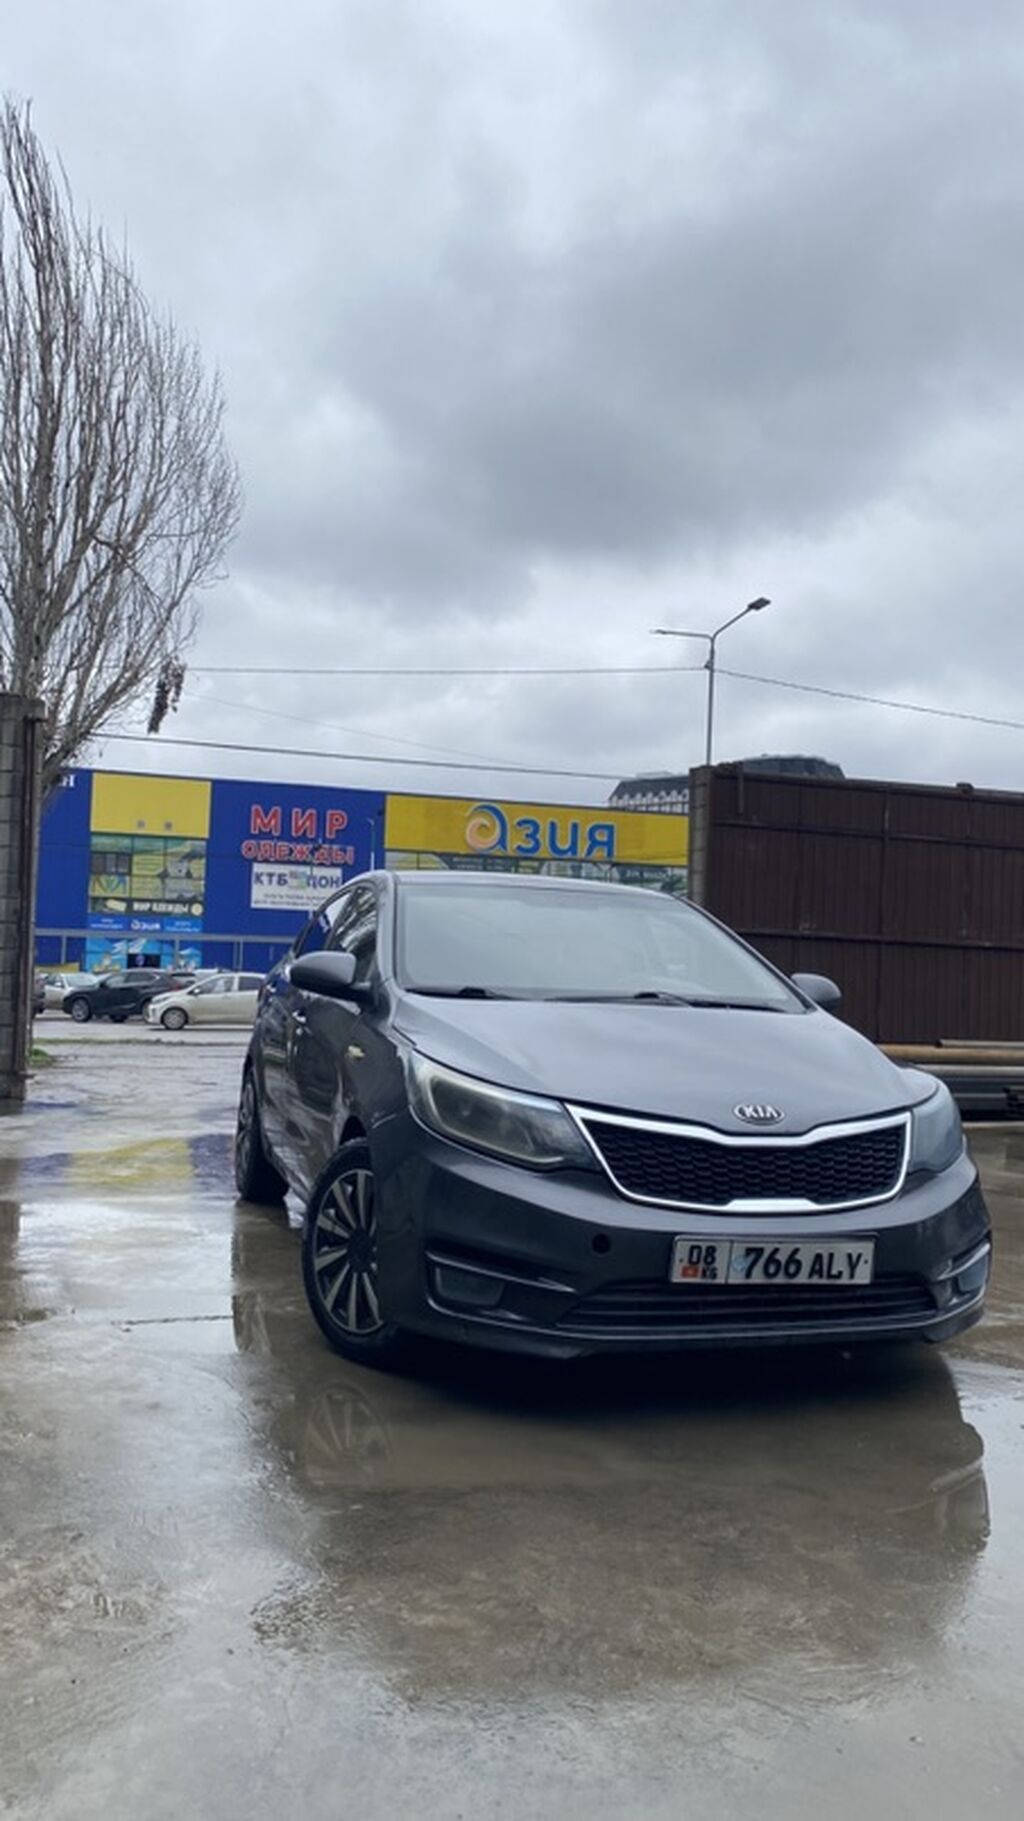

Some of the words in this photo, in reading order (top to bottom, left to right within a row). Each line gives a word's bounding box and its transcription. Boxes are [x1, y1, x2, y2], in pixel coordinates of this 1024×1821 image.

[250, 804, 348, 839] МИР
[241, 840, 354, 865] ОДЕЖДЫ
[253, 871, 289, 887] КТБ
[743, 1104, 779, 1118] KIA
[688, 1245, 717, 1266] 08
[744, 1247, 803, 1280] 766
[808, 1252, 863, 1280] ALY
